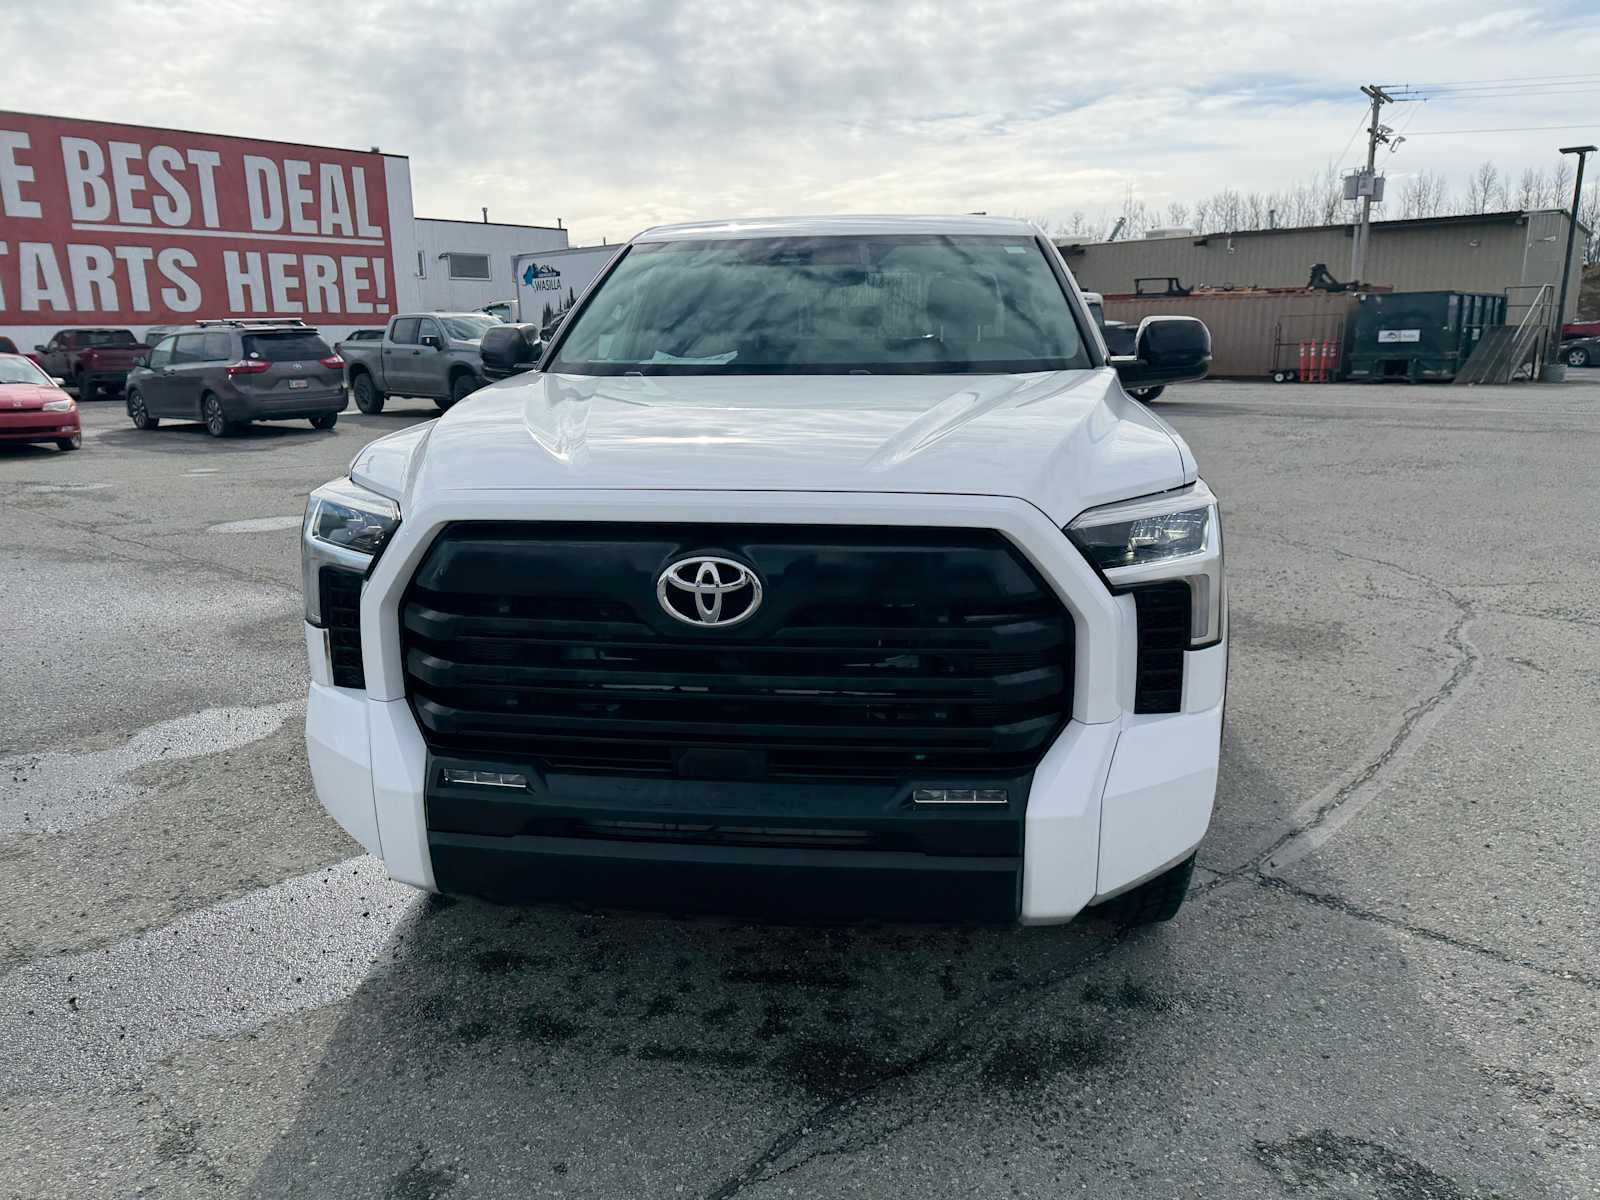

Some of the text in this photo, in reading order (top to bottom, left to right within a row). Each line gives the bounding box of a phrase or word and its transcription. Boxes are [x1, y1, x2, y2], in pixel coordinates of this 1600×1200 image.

[60, 136, 220, 228] BEST
[243, 154, 383, 238] DEAL
[223, 250, 390, 314] HERE!
[533, 277, 562, 293] WASILLA
